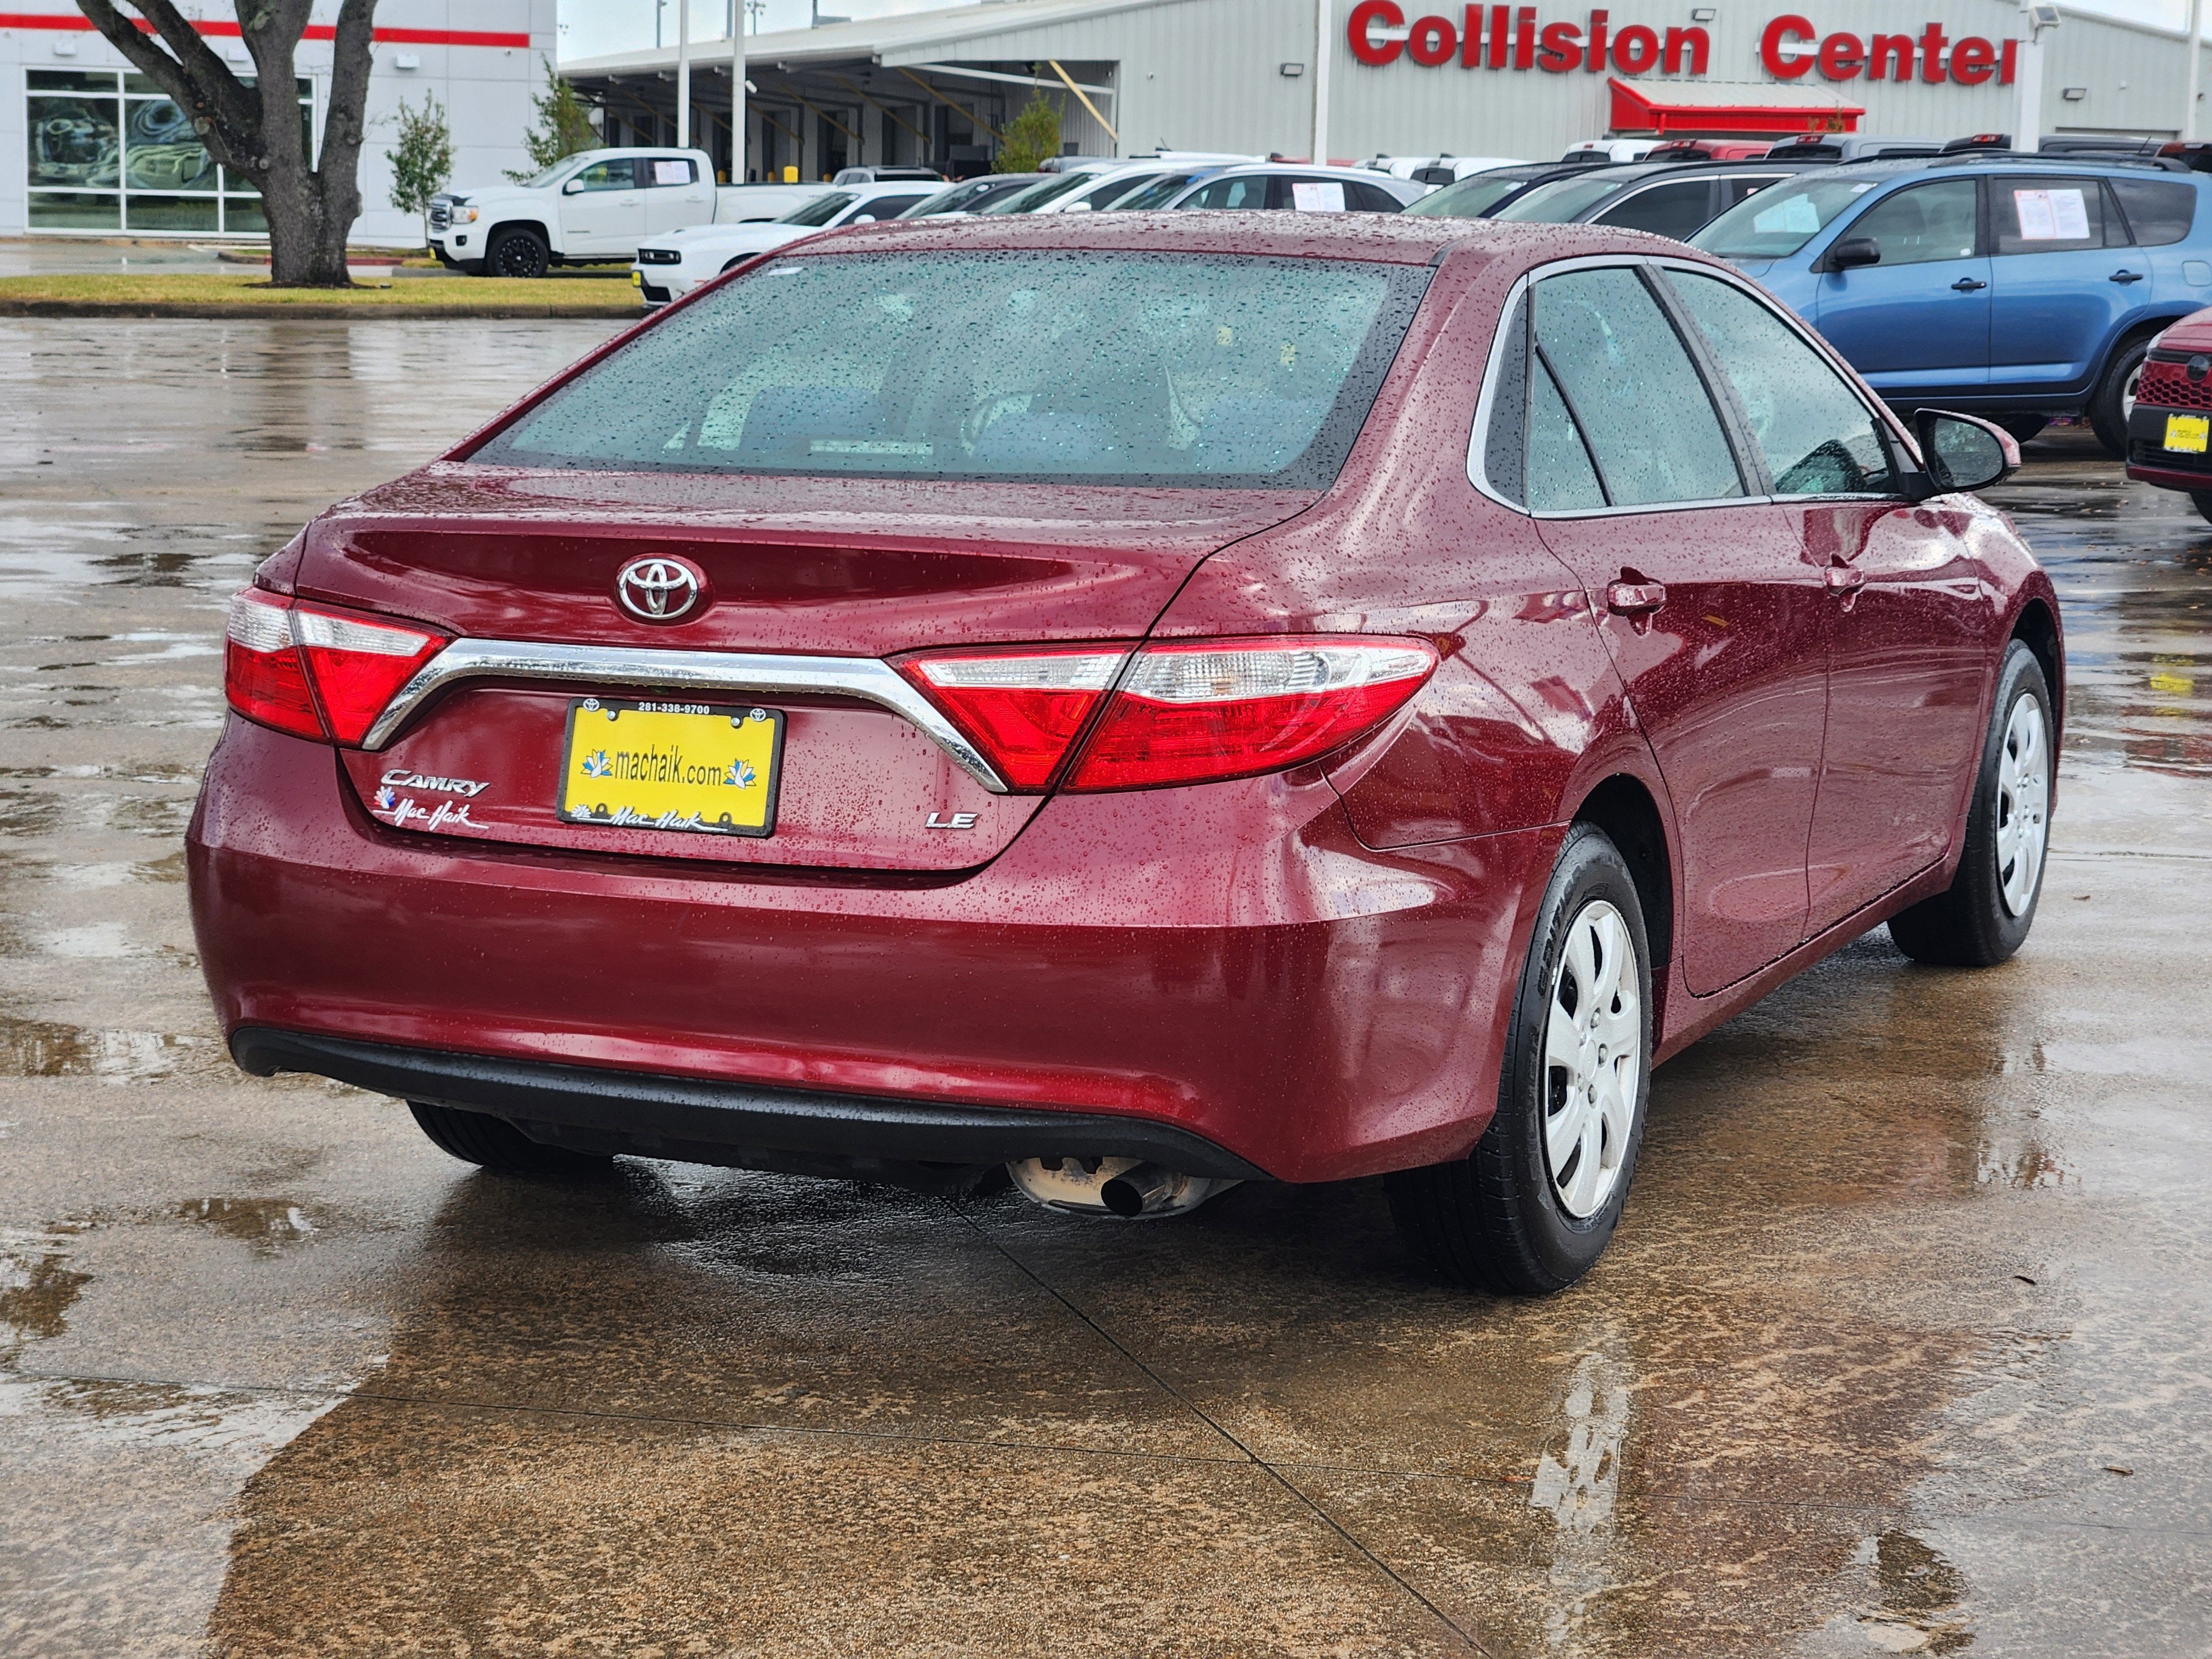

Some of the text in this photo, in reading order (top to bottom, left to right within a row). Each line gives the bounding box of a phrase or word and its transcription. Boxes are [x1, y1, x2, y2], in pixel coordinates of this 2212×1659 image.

[1347, 0, 2017, 85] Collision Center
[638, 701, 710, 714] 281-338-9700
[614, 744, 721, 786] machaik.com
[373, 798, 490, 831] Mac Haik
[577, 806, 728, 831] Mac Haik
[924, 811, 979, 829] LE
